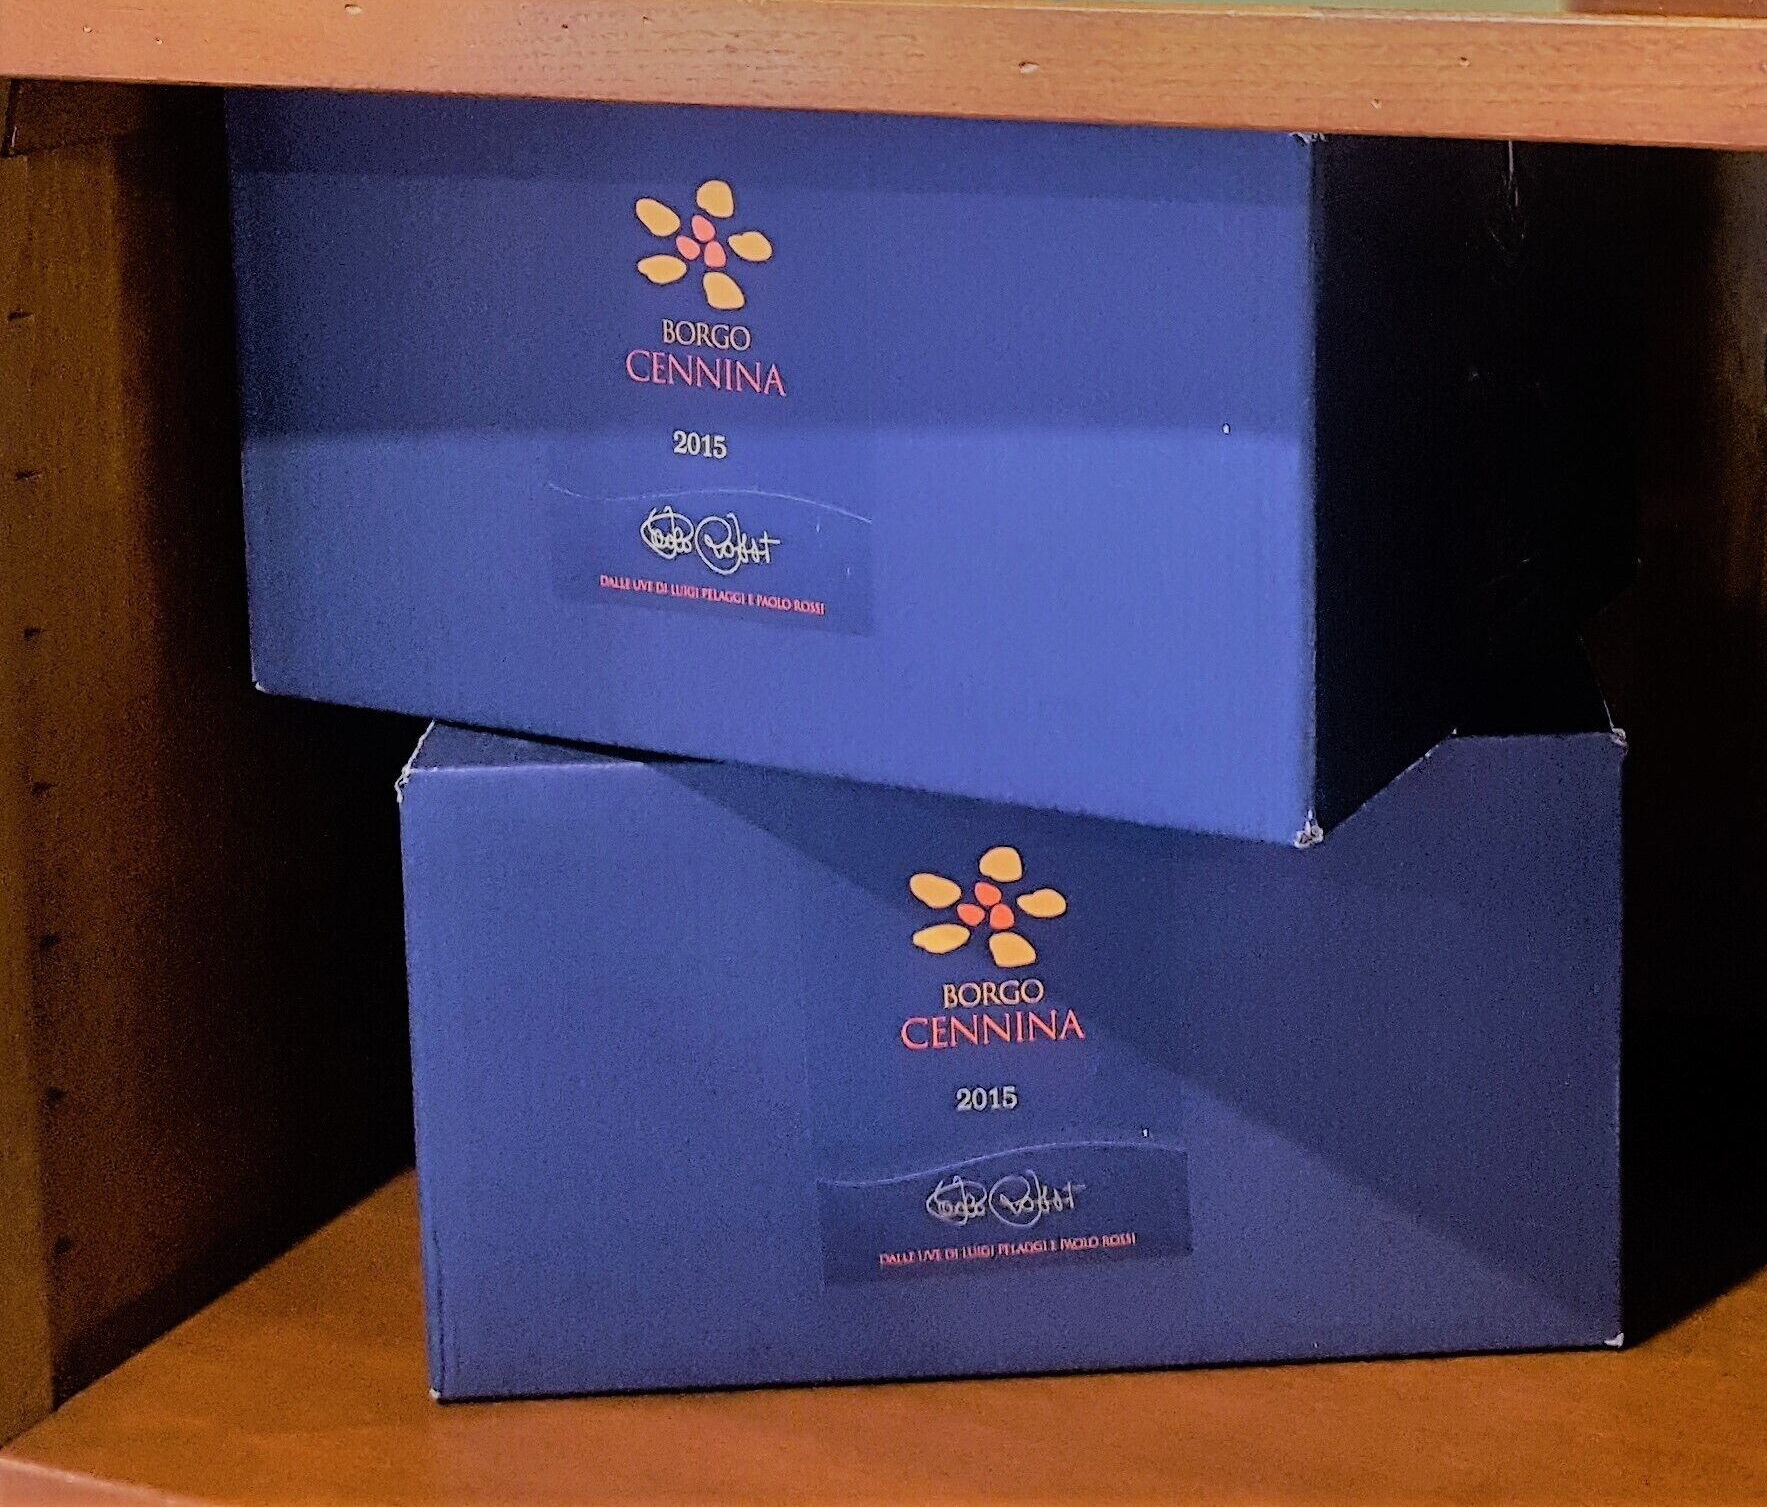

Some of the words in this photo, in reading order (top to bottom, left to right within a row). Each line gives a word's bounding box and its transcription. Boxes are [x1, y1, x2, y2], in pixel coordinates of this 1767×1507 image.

[662, 319, 751, 351] BORGO
[626, 348, 787, 397] CENNINA
[673, 429, 728, 460] 2015
[600, 574, 630, 590] DALLE
[633, 579, 653, 592] UVE
[656, 581, 668, 594] DI
[671, 583, 699, 598] LUIGI
[701, 587, 745, 605] PELAGGI
[748, 593, 753, 606] E
[757, 594, 792, 611] PAOLO
[794, 599, 825, 615] ROSSI
[942, 979, 1044, 1010] BORGO
[900, 1008, 1086, 1051] CENNINA
[955, 1085, 1018, 1112] 2015
